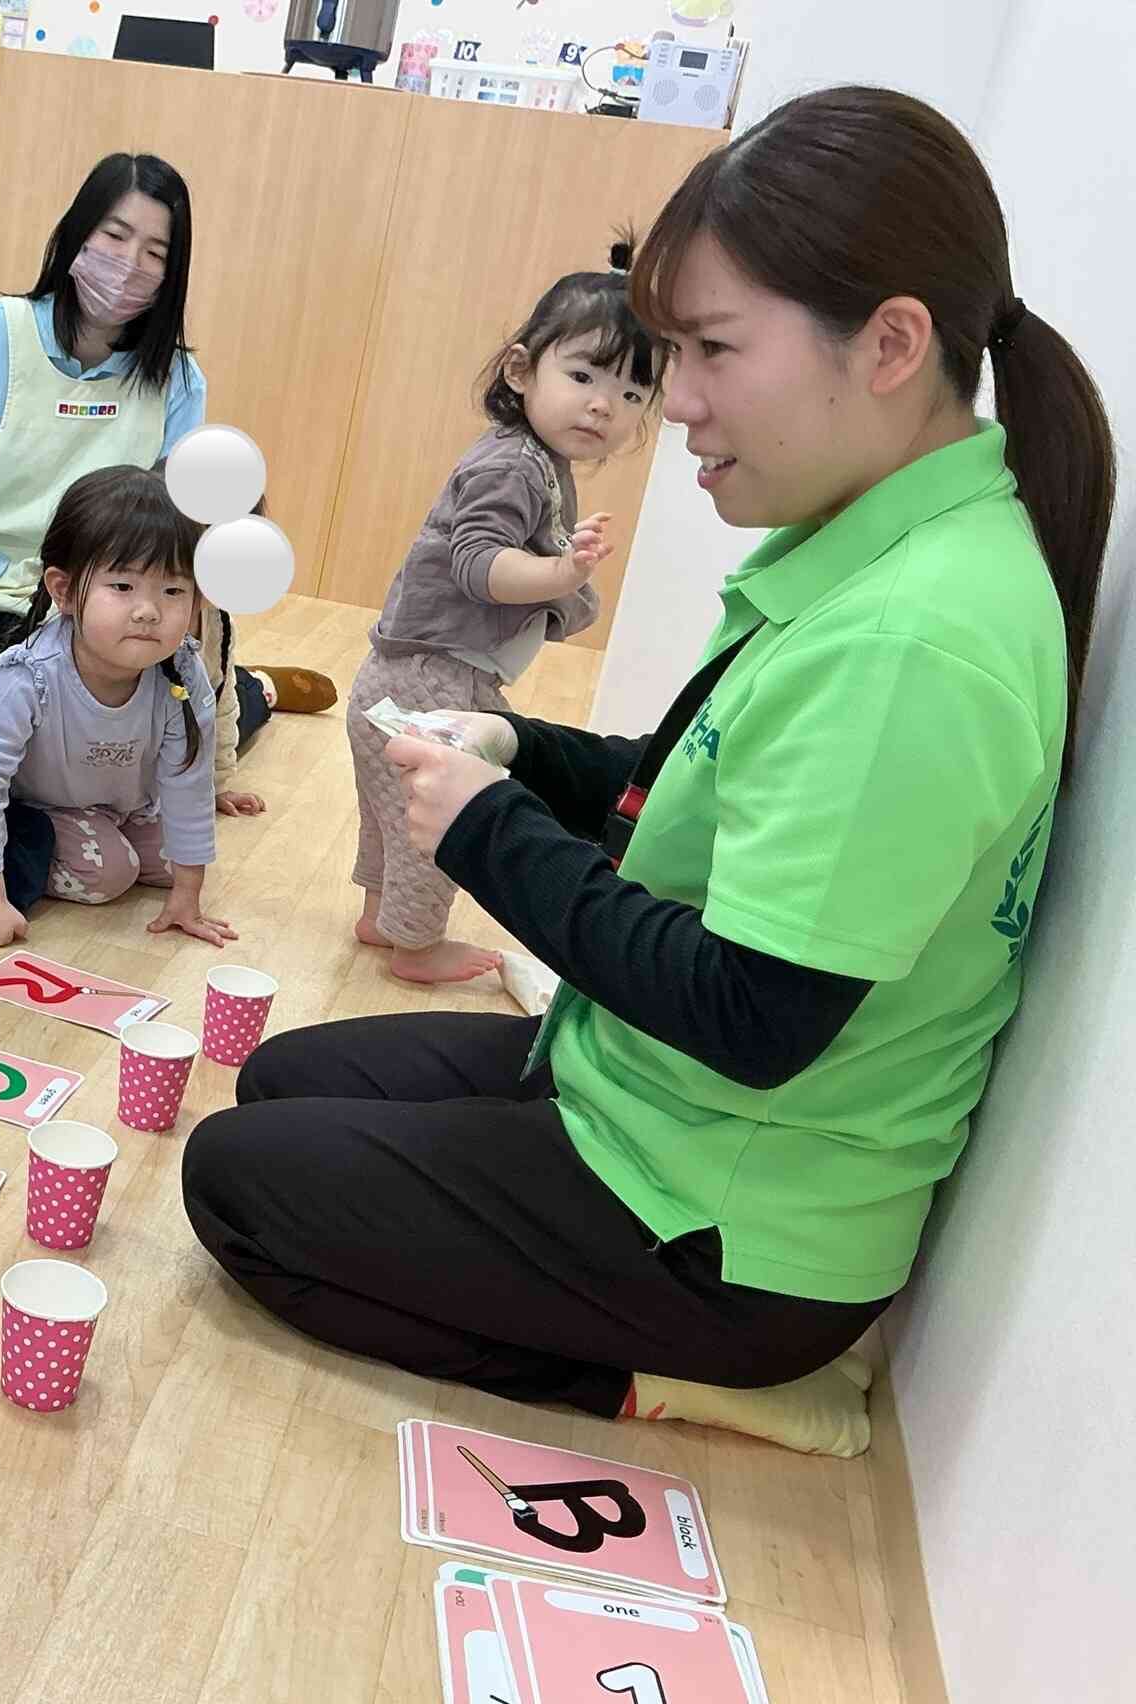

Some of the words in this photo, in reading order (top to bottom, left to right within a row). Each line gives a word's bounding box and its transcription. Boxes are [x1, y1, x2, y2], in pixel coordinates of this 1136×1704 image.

[457, 42, 475, 60] 10
[565, 42, 578, 61] 9
[507, 1479, 647, 1553] B
[676, 1515, 697, 1550] black
[602, 1603, 641, 1618] one
